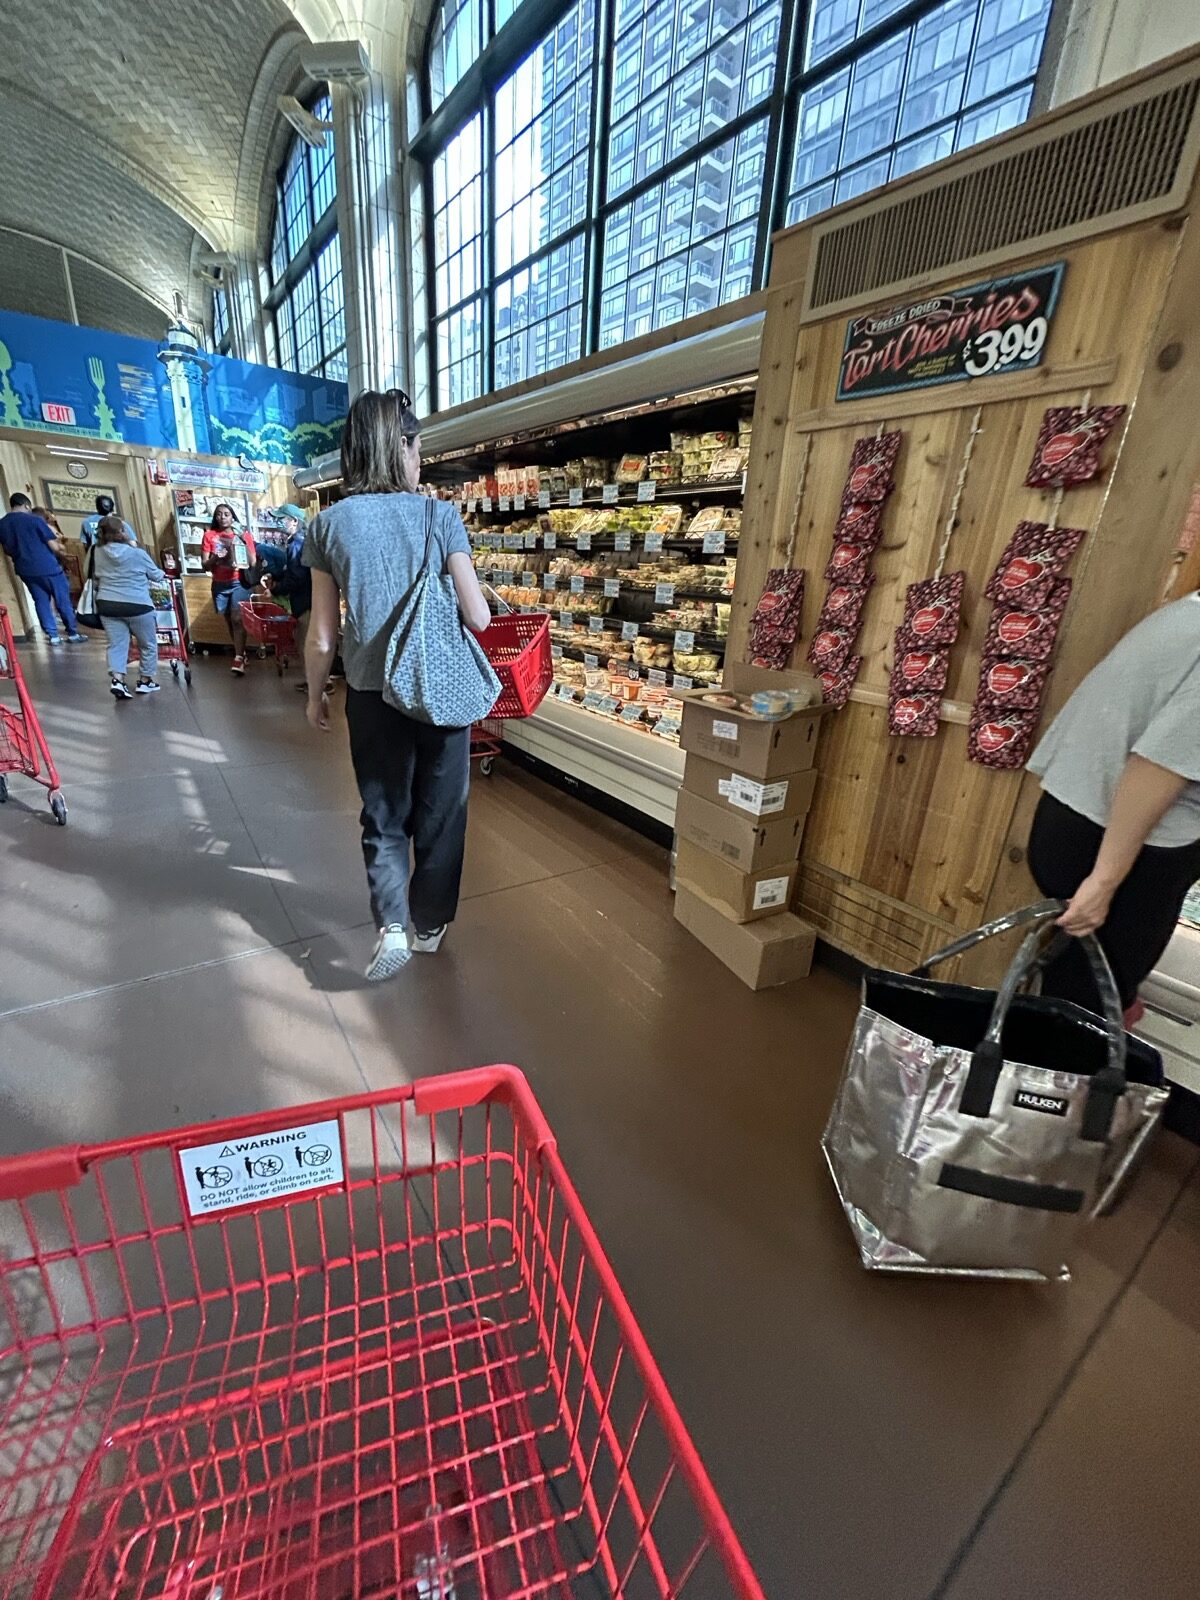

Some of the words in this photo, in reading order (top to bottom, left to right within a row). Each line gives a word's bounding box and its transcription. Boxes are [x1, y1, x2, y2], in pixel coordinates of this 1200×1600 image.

[871, 312, 908, 332] FREEZE
[908, 300, 941, 320] DRIED
[843, 339, 897, 391] Tart
[894, 286, 1040, 370] Cherries
[962, 316, 1048, 377] $3.99
[47, 405, 71, 423] EXIT
[1018, 1093, 1062, 1109] HULKEN
[235, 1131, 307, 1152] WARNING
[200, 1192, 216, 1202] DO
[218, 1187, 241, 1198] NOT
[242, 1182, 268, 1193] allow
[269, 1173, 307, 1186] children
[308, 1170, 319, 1178] to
[320, 1168, 335, 1177] sit,
[203, 1197, 234, 1208] stand,
[236, 1191, 258, 1202] ride,
[272, 1182, 298, 1193] climb
[299, 1179, 311, 1187] on
[313, 1174, 334, 1184] cart.
